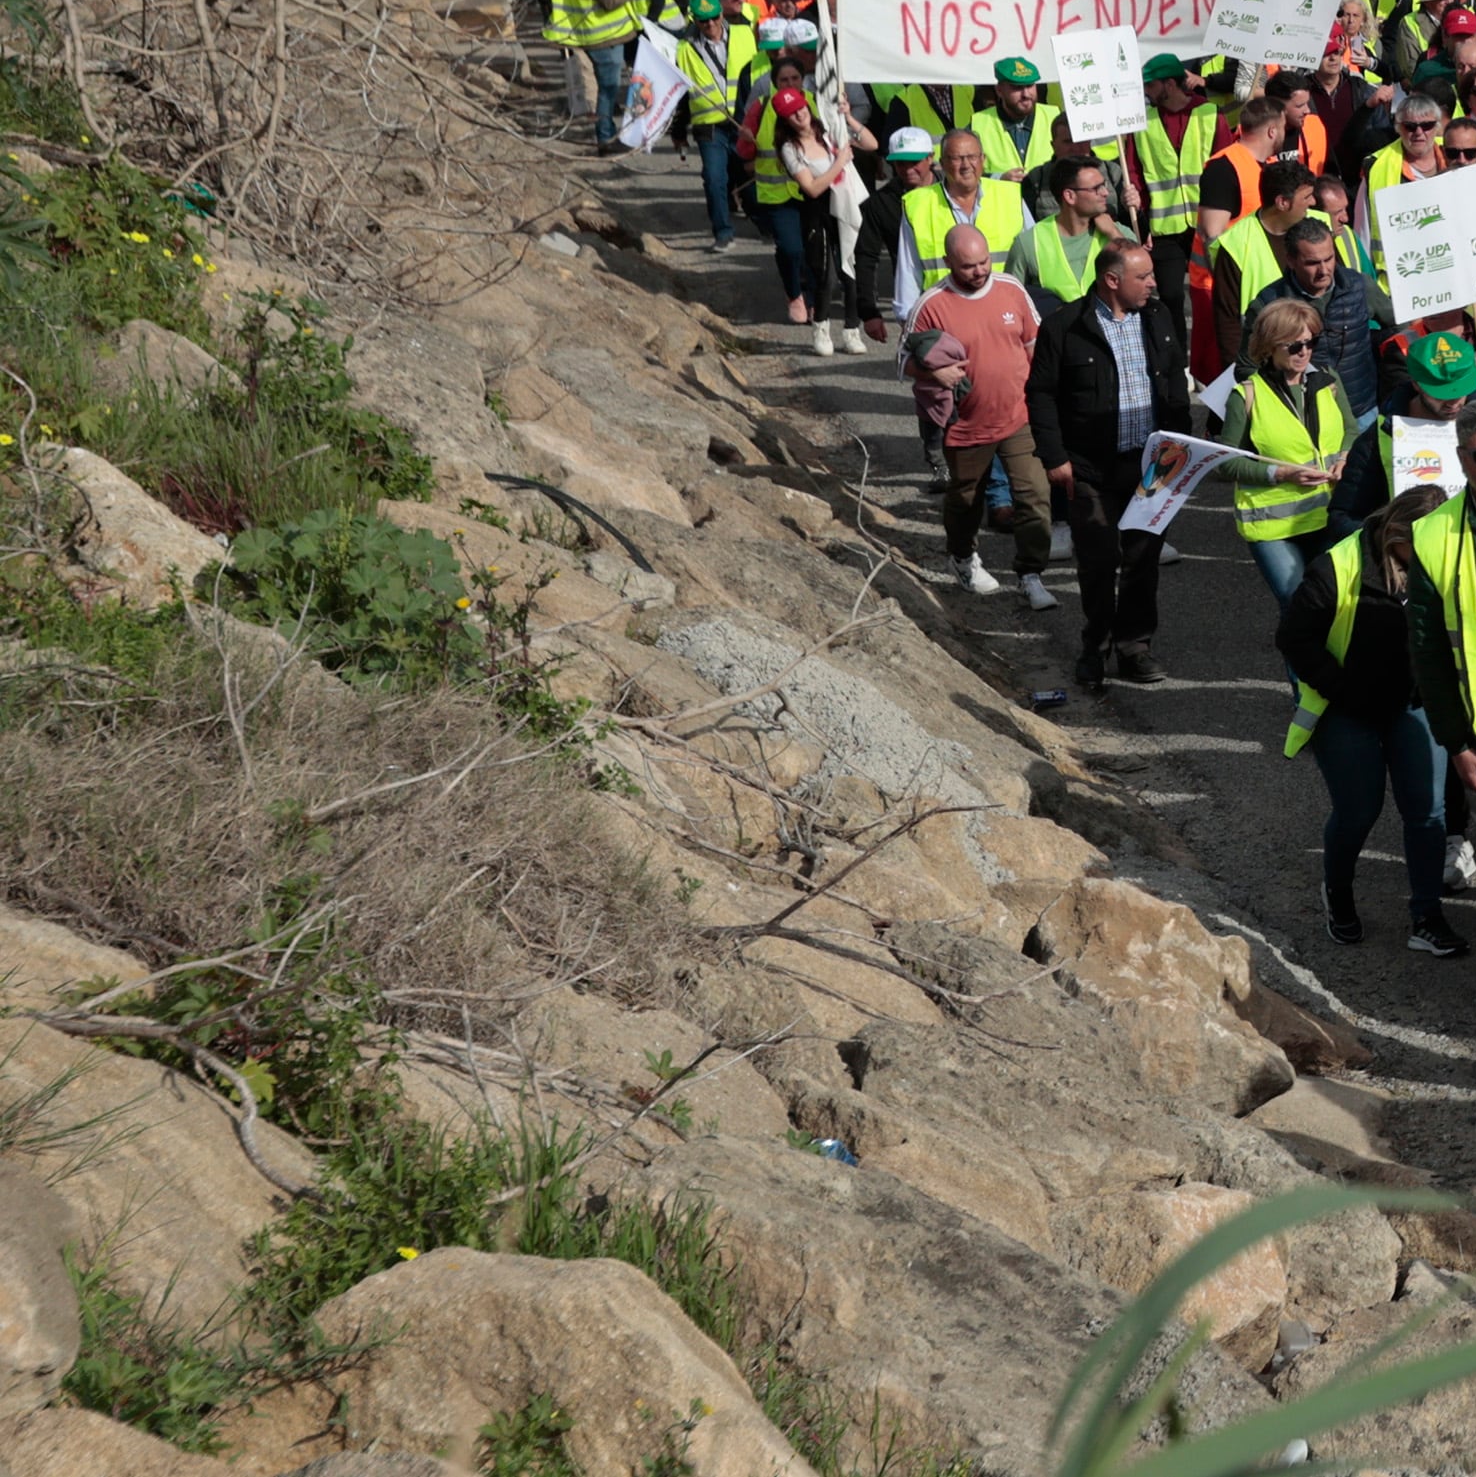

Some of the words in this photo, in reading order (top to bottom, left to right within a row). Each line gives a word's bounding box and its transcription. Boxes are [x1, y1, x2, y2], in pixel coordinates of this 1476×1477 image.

[900, 0, 998, 57] NOS
[1215, 39, 1230, 51] Por
[1231, 44, 1246, 54] un
[1264, 49, 1295, 65] Campo
[1296, 51, 1317, 64] Vivo
[1082, 121, 1095, 133] Por
[1116, 115, 1134, 129] Campo
[1389, 205, 1441, 227] COAG
[1426, 242, 1452, 258] UPA
[1411, 295, 1433, 310] Por
[1435, 291, 1452, 303] un
[1393, 456, 1440, 468] COAG
